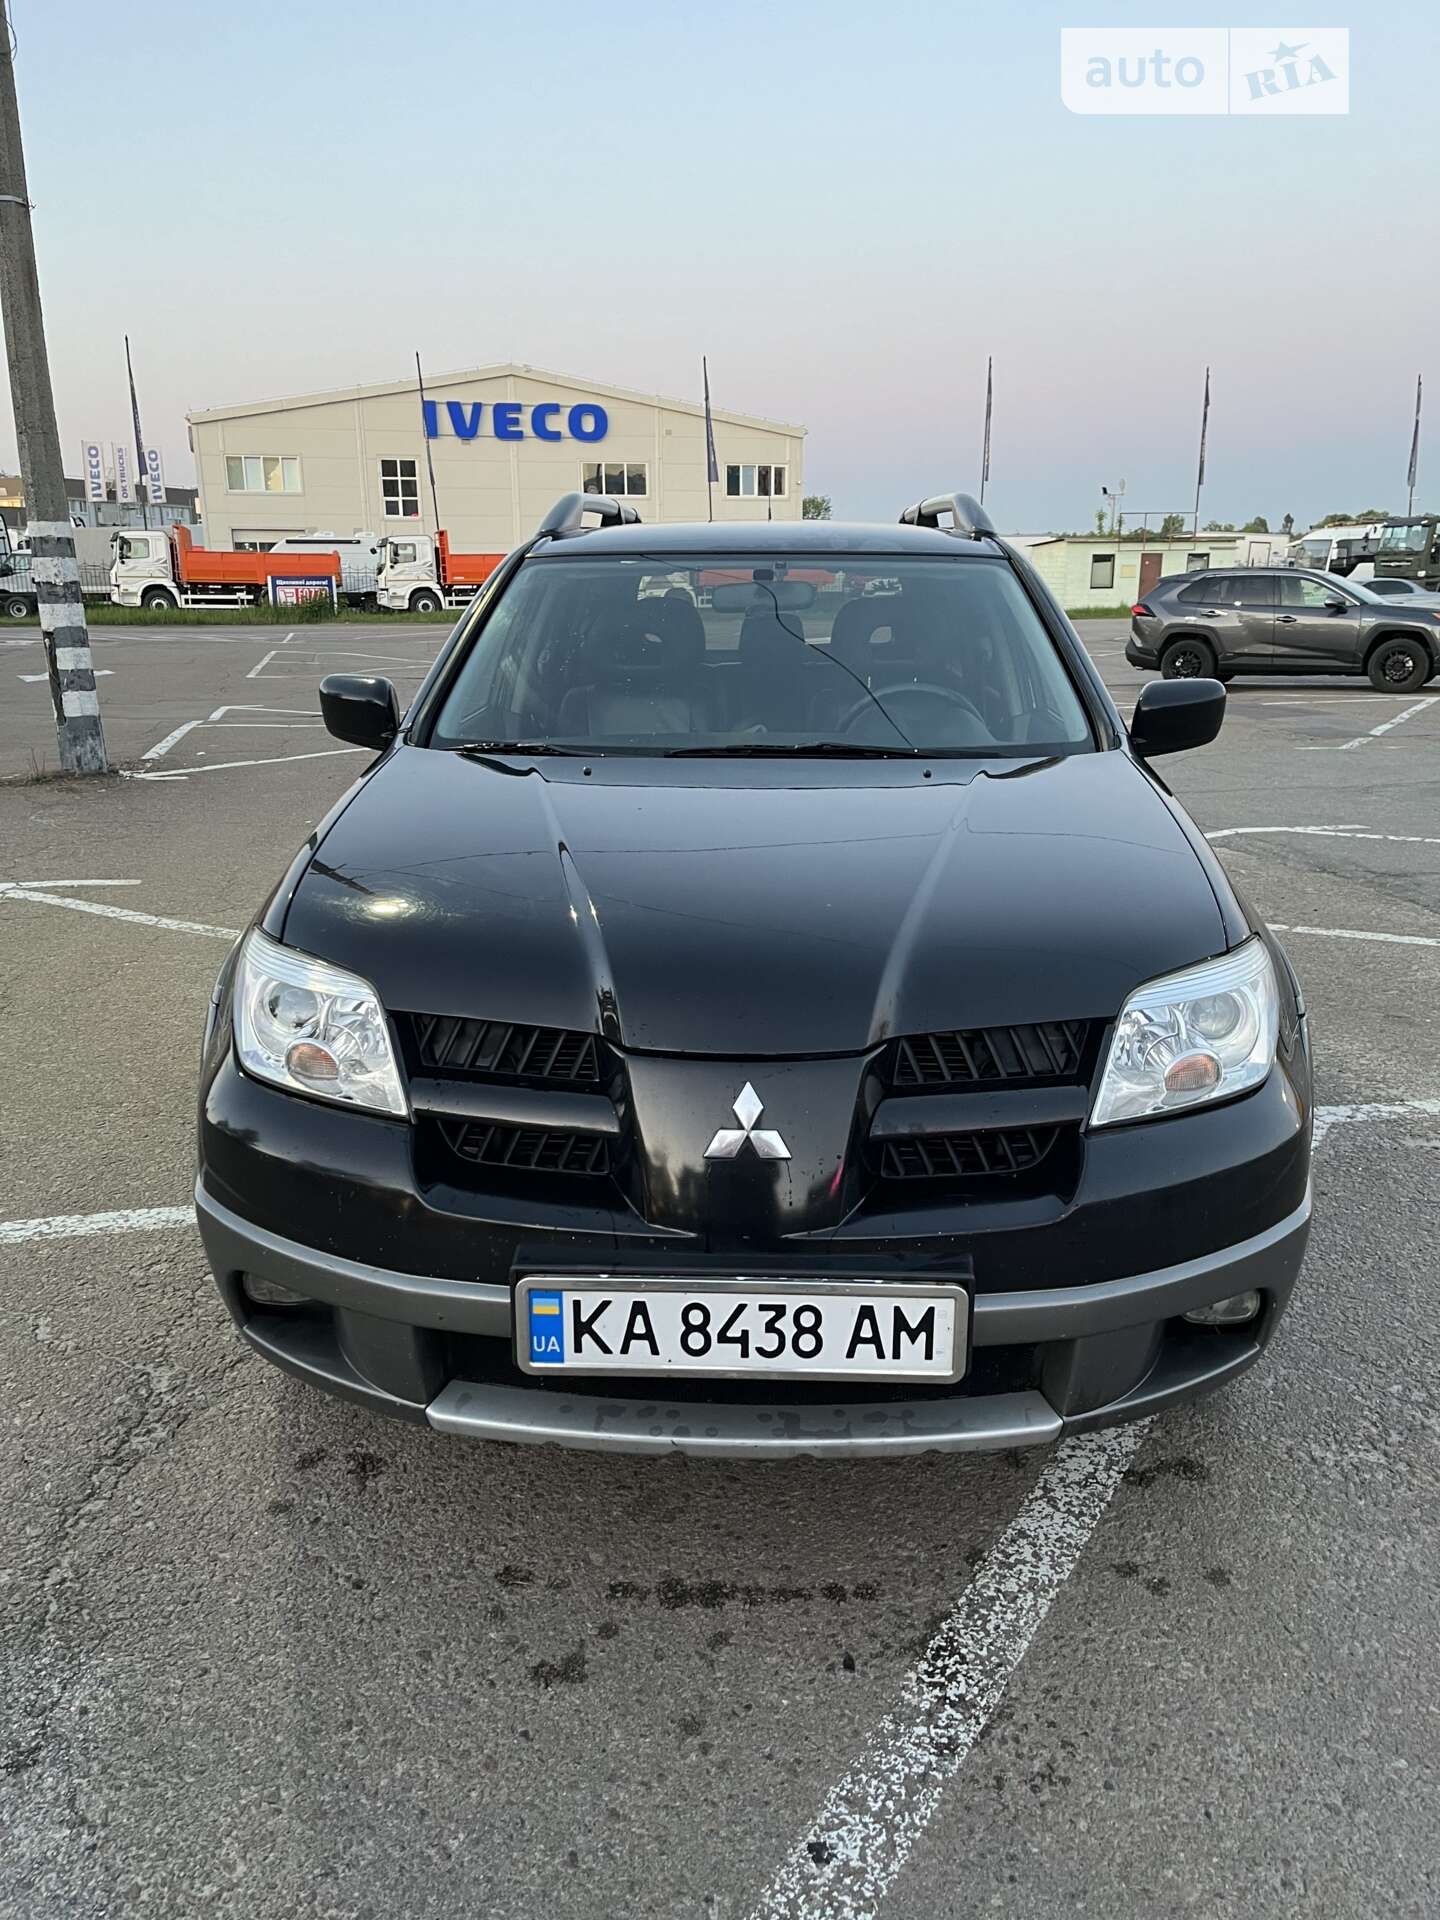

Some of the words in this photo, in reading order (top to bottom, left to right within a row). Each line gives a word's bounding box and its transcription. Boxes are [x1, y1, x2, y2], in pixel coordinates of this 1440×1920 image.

[422, 399, 609, 444] IVECO
[87, 445, 103, 498] IVECO
[117, 447, 127, 483] TRUCKS
[147, 449, 163, 500] IVECO
[121, 485, 129, 499] OK
[533, 1335, 560, 1352] UA
[572, 1298, 660, 1357] KA
[679, 1301, 824, 1360] 8438
[845, 1304, 937, 1361] AM
